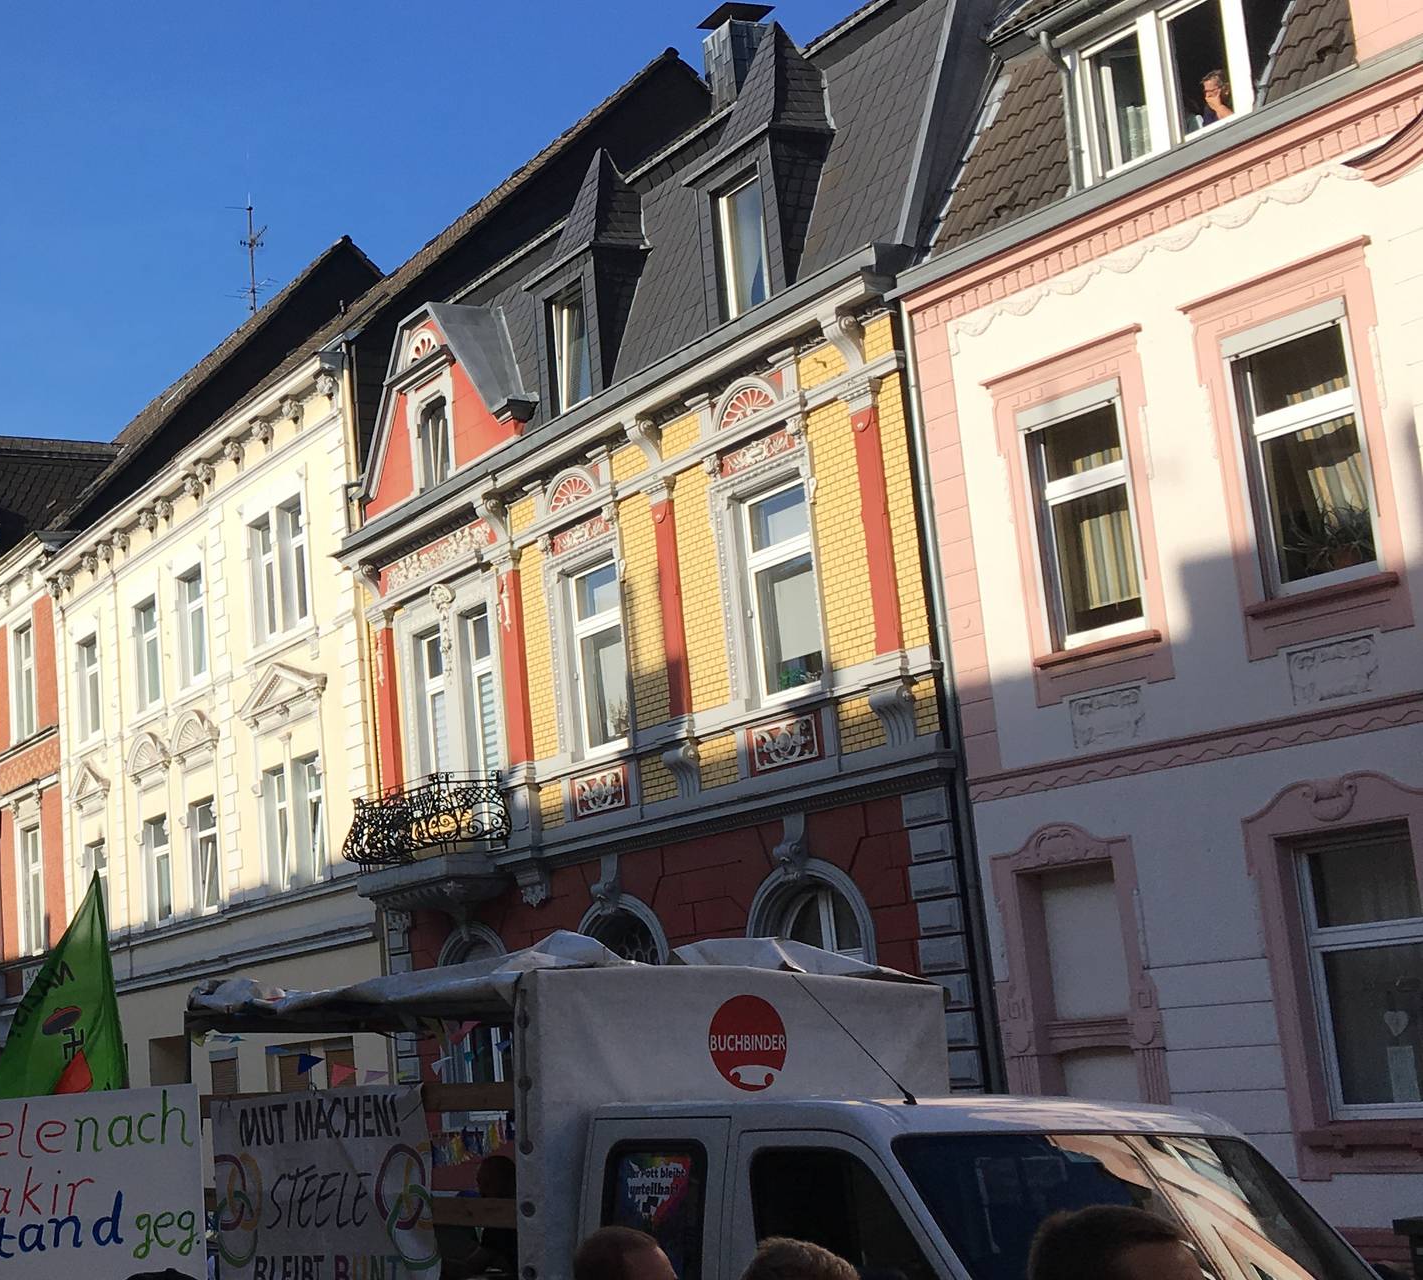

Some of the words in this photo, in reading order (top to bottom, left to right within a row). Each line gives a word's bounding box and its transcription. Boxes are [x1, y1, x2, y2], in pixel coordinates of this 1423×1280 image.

[710, 1034, 786, 1051] BUCHBINDER
[73, 1089, 194, 1153] nach
[240, 1103, 288, 1147] MUT
[295, 1094, 401, 1142] MACHEN!
[266, 1165, 372, 1229] STEELE
[254, 1255, 325, 1280] BLEIBT
[334, 1255, 402, 1280] BUNT
